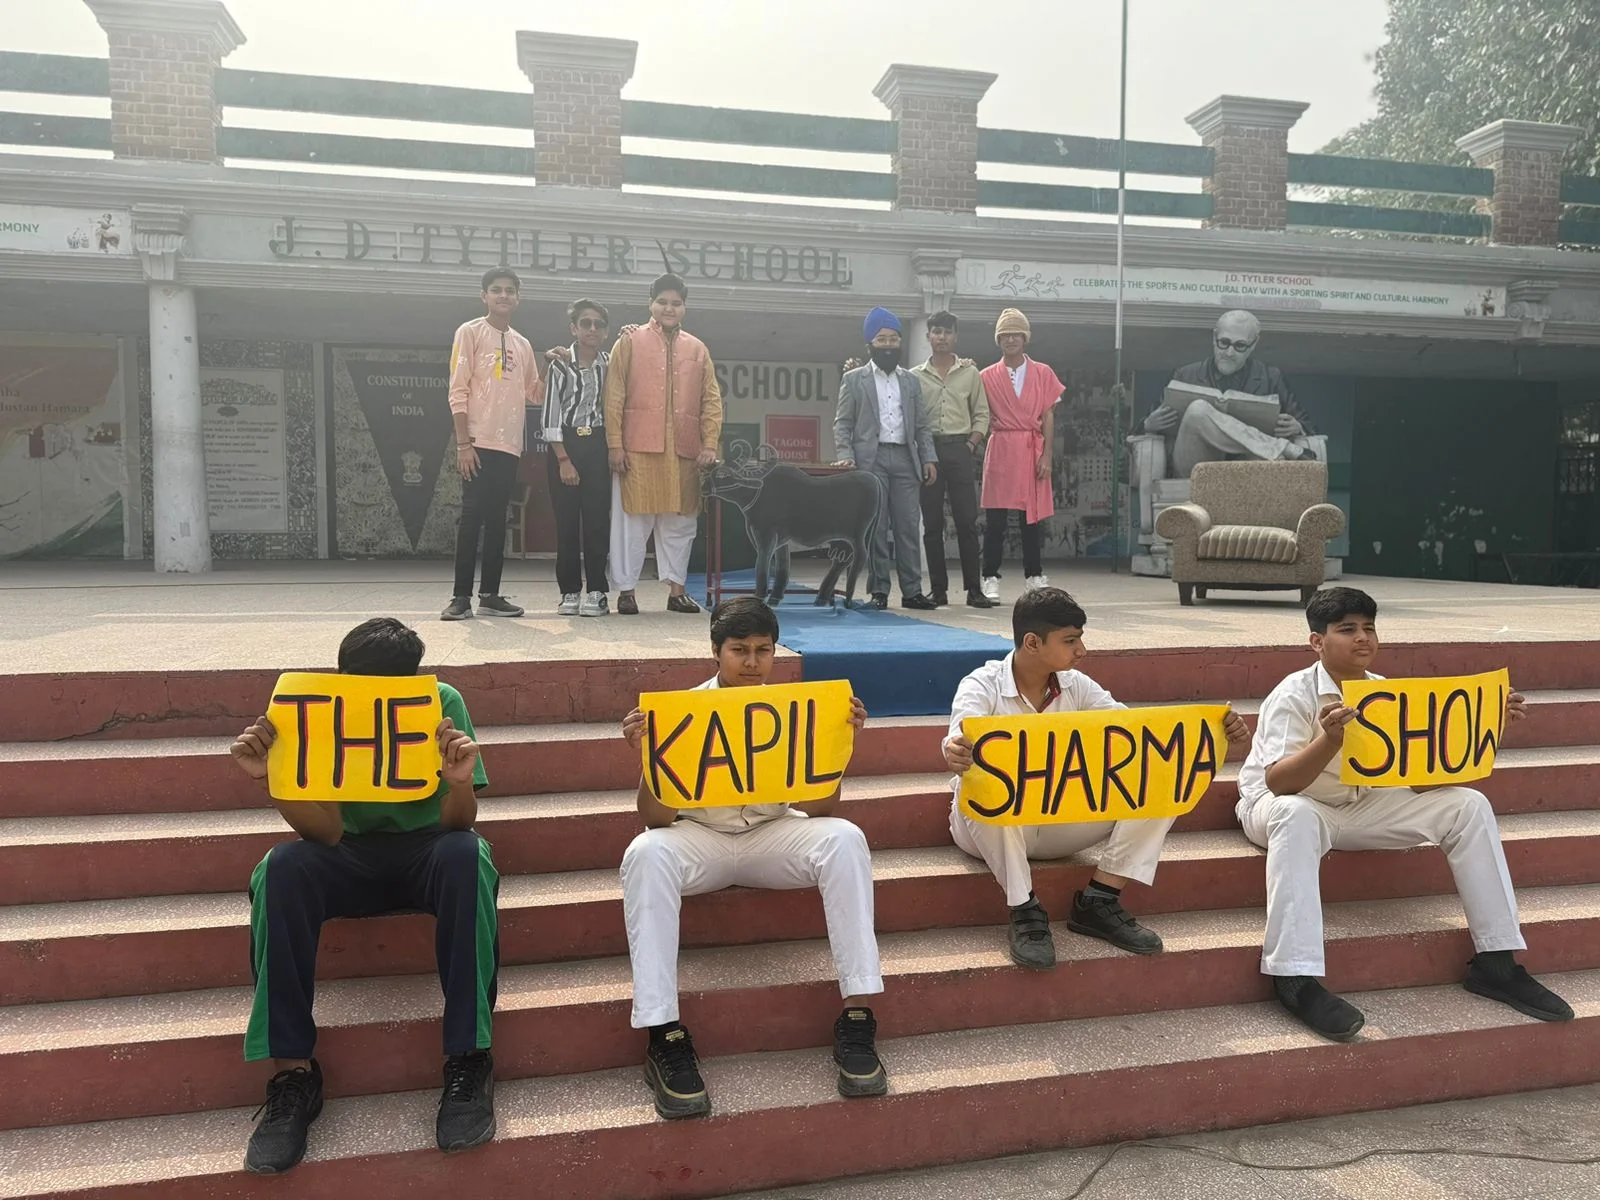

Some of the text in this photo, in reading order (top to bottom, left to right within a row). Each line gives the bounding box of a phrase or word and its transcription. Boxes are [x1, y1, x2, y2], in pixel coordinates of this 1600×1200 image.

[413, 223, 632, 275] TYTLER
[666, 238, 853, 287] SCHOOL
[1127, 280, 1143, 289] THE
[1145, 281, 1178, 291] SPORTS
[1199, 284, 1240, 294] CULTURAL
[1241, 286, 1259, 295] DAY
[1259, 287, 1281, 296] WITH
[1289, 289, 1329, 298] SPORTING
[1330, 290, 1354, 300] SPIRIT
[1354, 292, 1372, 301] AND
[1373, 293, 1411, 303] CULTURAL
[1412, 295, 1450, 305] HARMONY
[1241, 275, 1274, 284] TYTLER
[1276, 276, 1314, 286] SCHOOL
[367, 375, 449, 388] CONSTITUTION
[715, 363, 829, 402] SCHOOL
[402, 392, 413, 400] OF
[391, 405, 424, 416] INDIA
[774, 438, 813, 448] TAGORE
[1349, 684, 1504, 777] SHOW
[646, 699, 843, 801] KAPIL
[967, 717, 1217, 818] SHARMA
